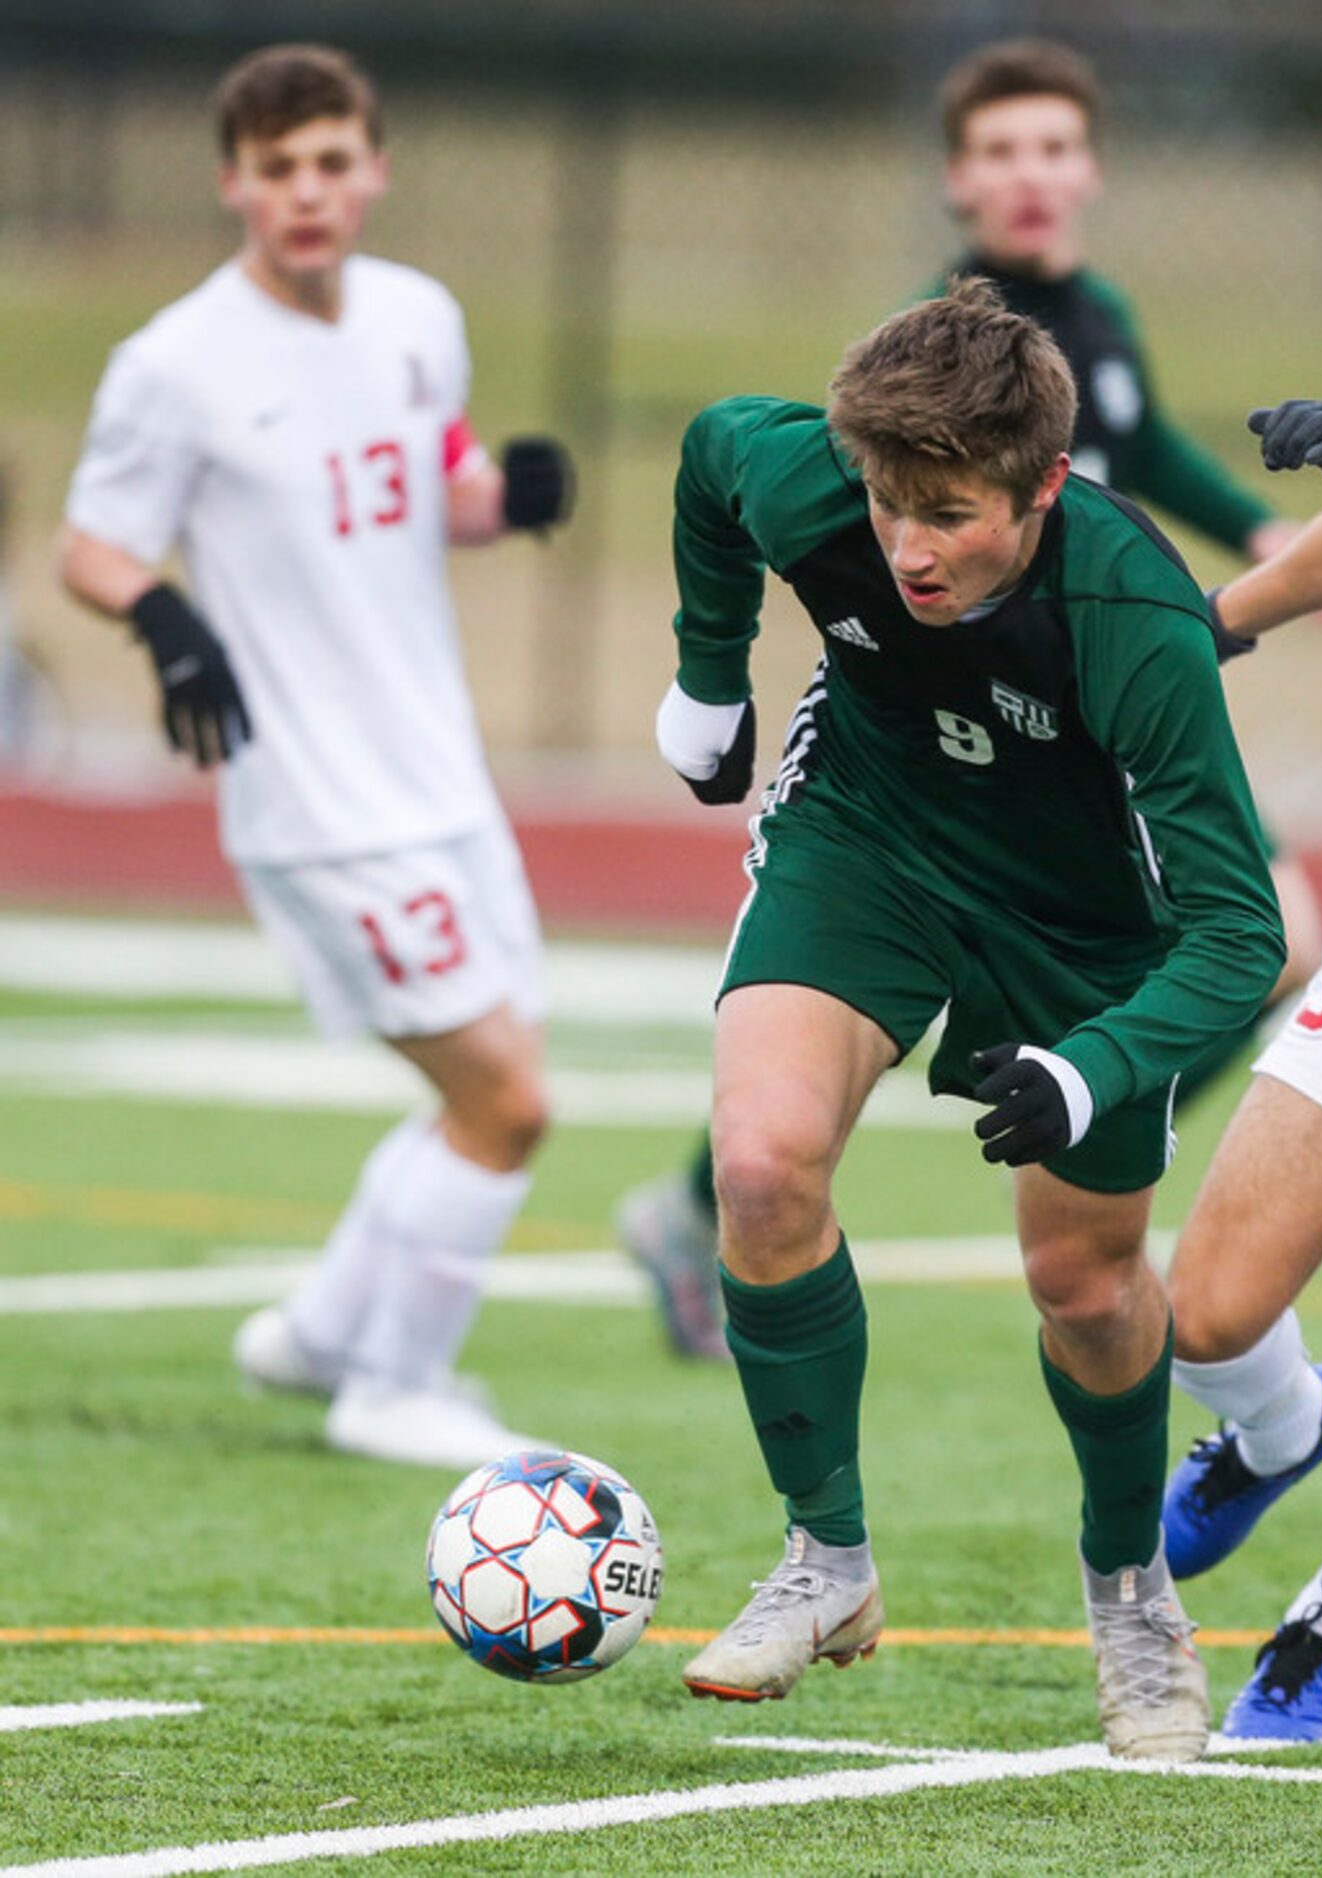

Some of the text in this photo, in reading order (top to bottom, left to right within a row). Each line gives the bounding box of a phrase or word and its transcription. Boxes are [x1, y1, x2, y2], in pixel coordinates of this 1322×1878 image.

[324, 441, 408, 537] 13
[934, 708, 996, 766] 9
[358, 888, 466, 987] 13
